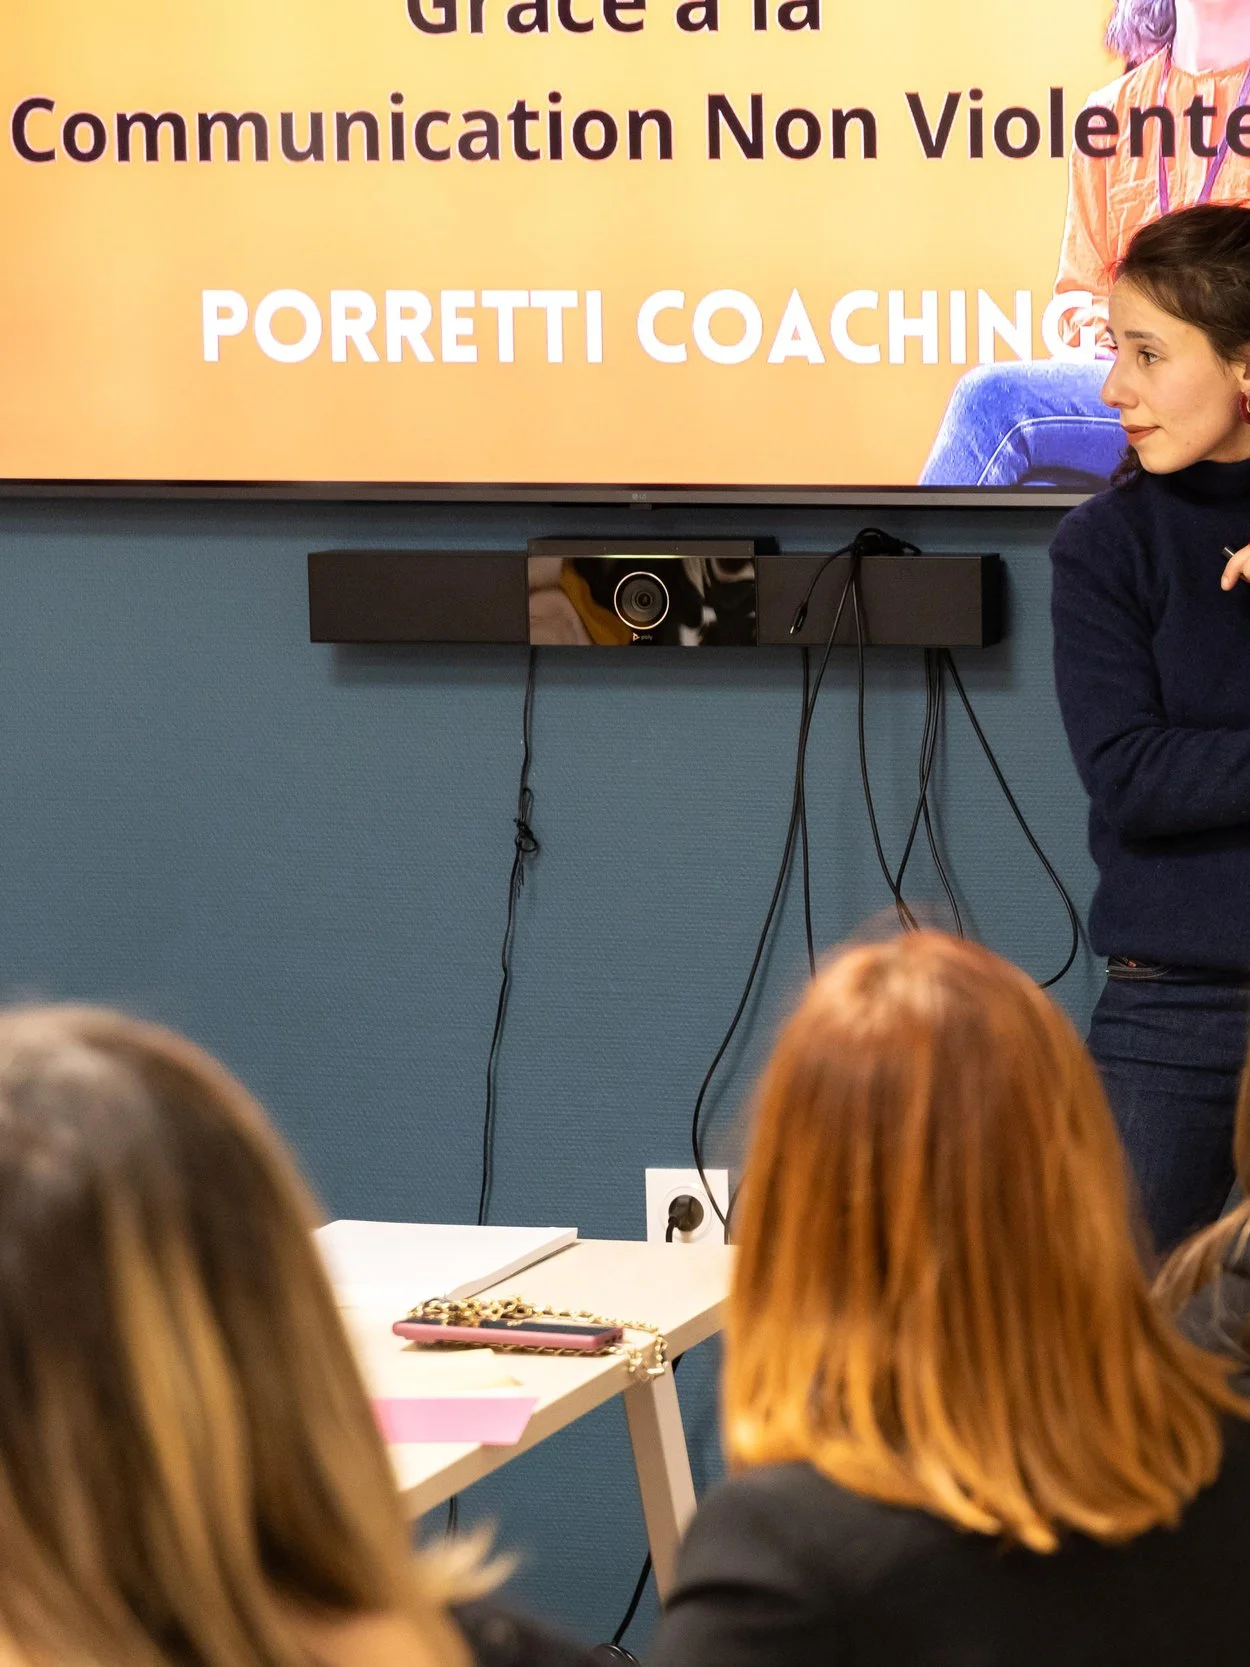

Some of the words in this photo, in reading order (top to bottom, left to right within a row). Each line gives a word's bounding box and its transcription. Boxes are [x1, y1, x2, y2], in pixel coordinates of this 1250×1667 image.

[11, 91, 673, 162] Communication
[707, 93, 877, 160] Non
[202, 289, 603, 363] PORRETTI
[637, 289, 1096, 364] COACHING
